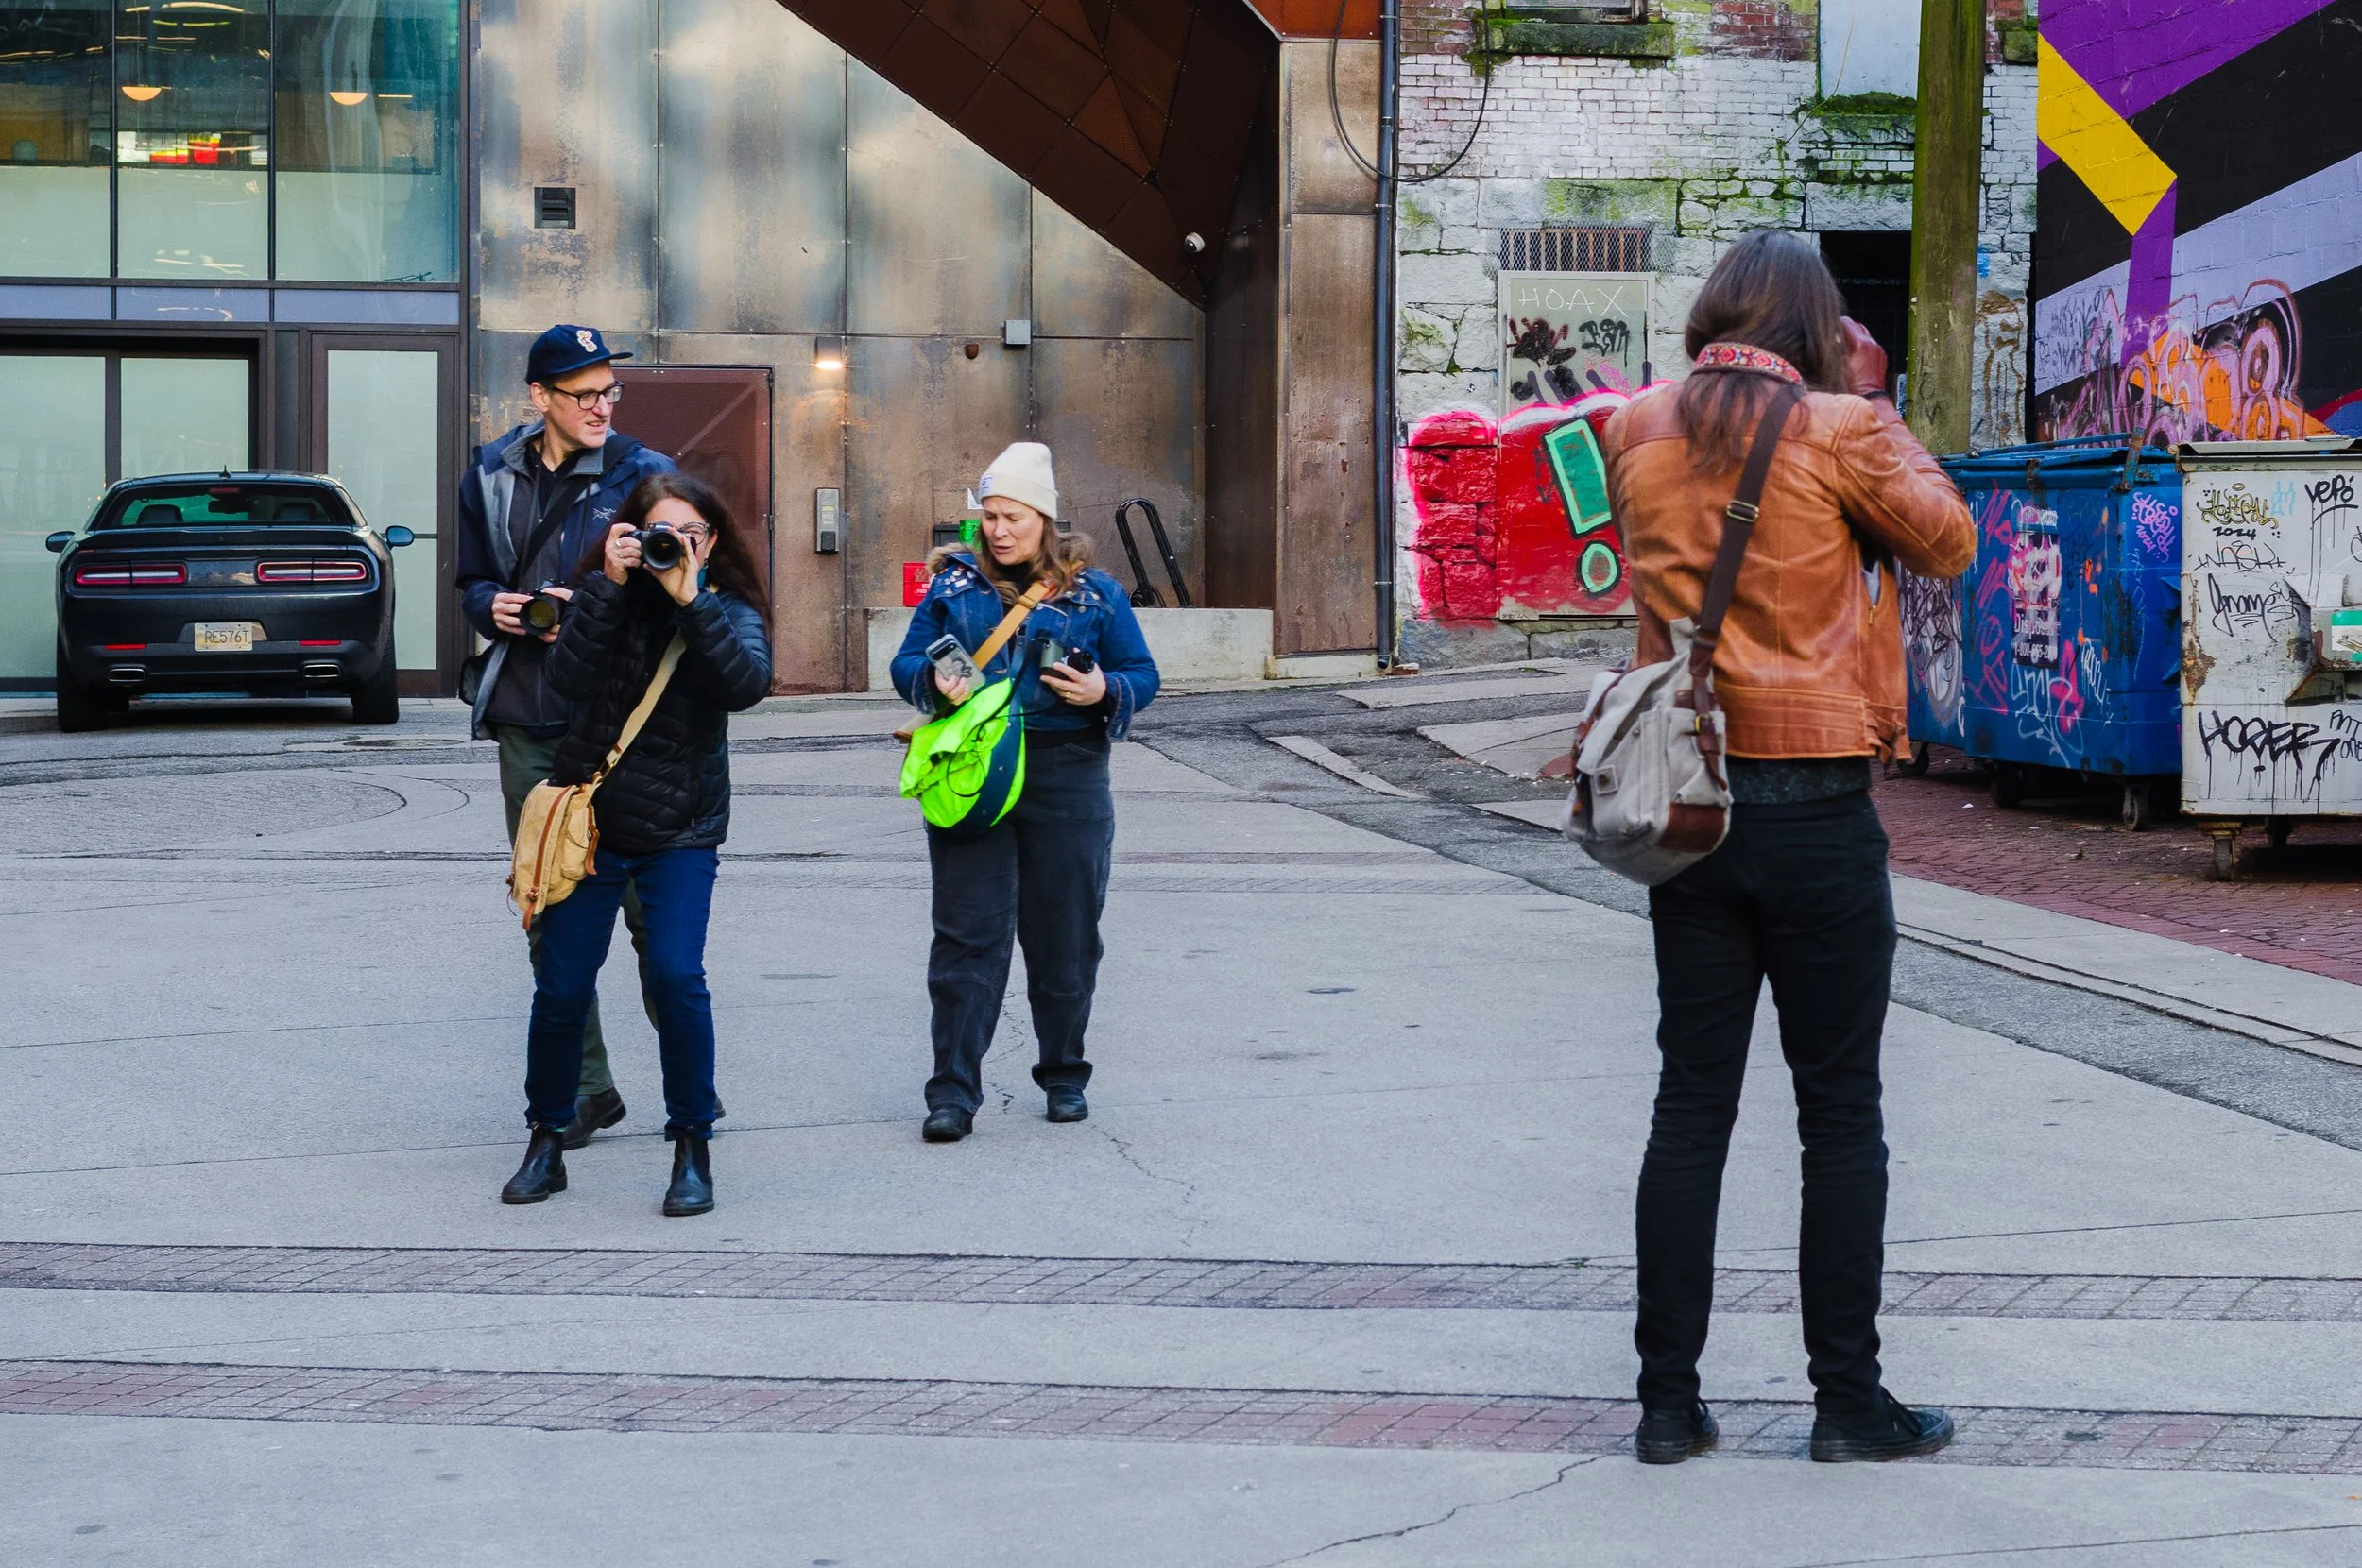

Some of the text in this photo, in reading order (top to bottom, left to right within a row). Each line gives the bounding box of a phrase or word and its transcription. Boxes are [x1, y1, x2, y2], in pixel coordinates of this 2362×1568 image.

[1518, 285, 1628, 317] HOAX
[2212, 526, 2257, 541] 2024
[2013, 612, 2054, 639] Dispos
[204, 630, 249, 644] RE576T
